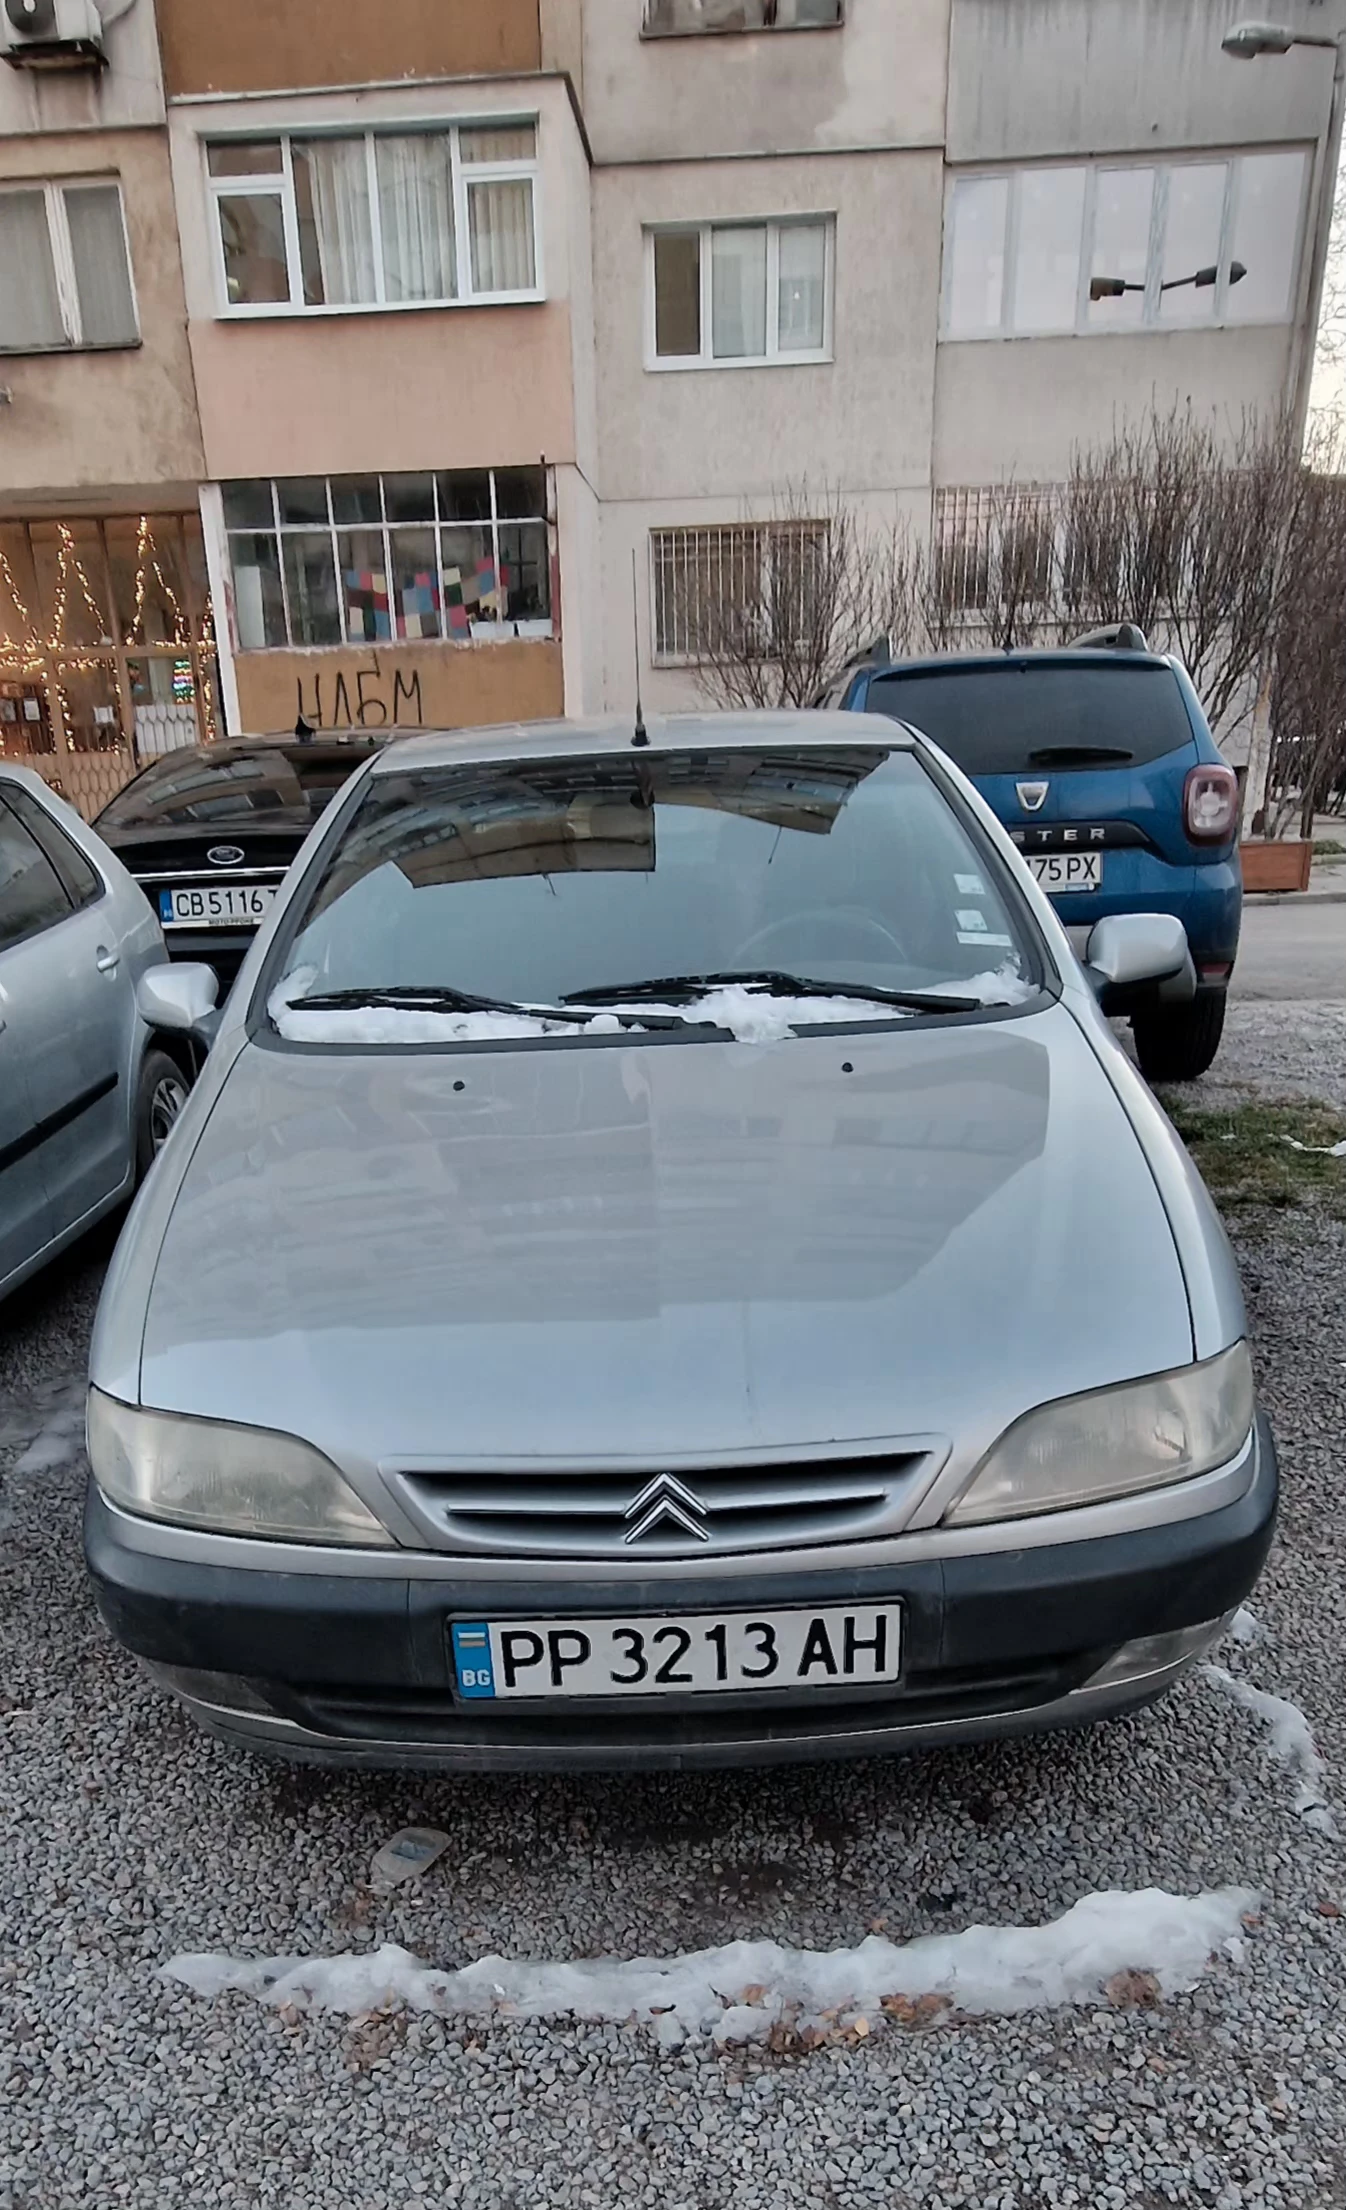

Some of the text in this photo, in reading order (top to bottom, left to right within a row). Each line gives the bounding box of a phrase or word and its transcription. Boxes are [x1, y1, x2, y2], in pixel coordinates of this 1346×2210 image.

[1027, 856, 1096, 882] 75 PX
[176, 892, 204, 917] CB
[208, 889, 263, 915] 5116
[500, 1614, 887, 1688] PP 3213 AH
[461, 1669, 491, 1688] BG
